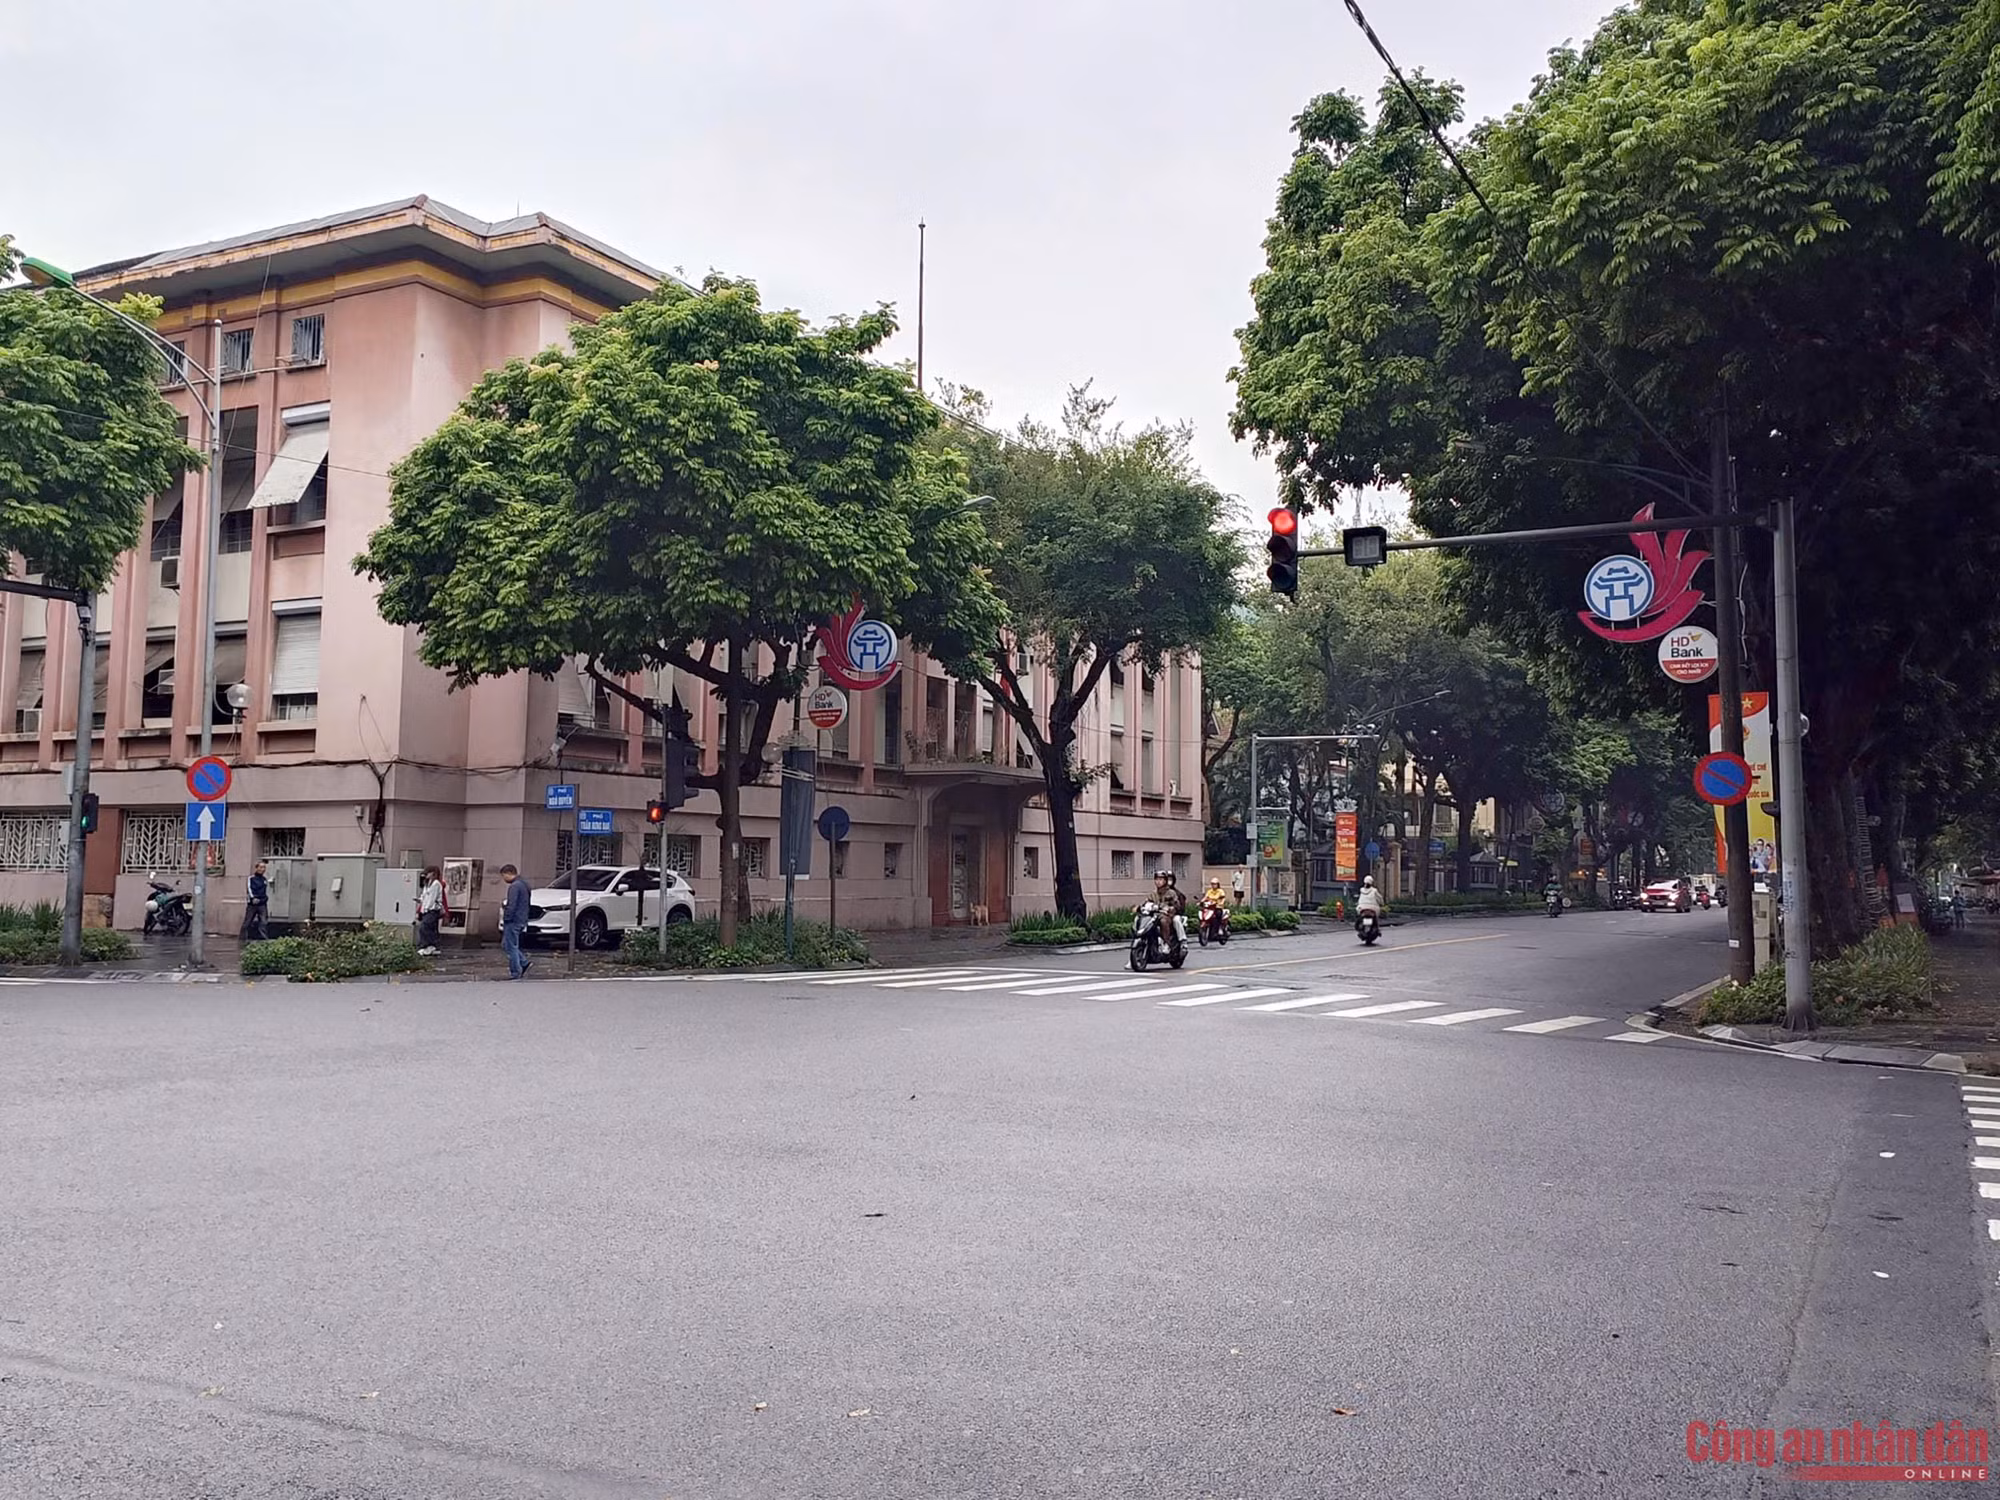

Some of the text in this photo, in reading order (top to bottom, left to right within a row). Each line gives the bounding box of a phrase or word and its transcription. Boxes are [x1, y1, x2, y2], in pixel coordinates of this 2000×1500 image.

[1671, 636, 1690, 647] HD
[1671, 647, 1703, 658] Bank
[815, 693, 826, 701] HD
[815, 700, 834, 709] Bank
